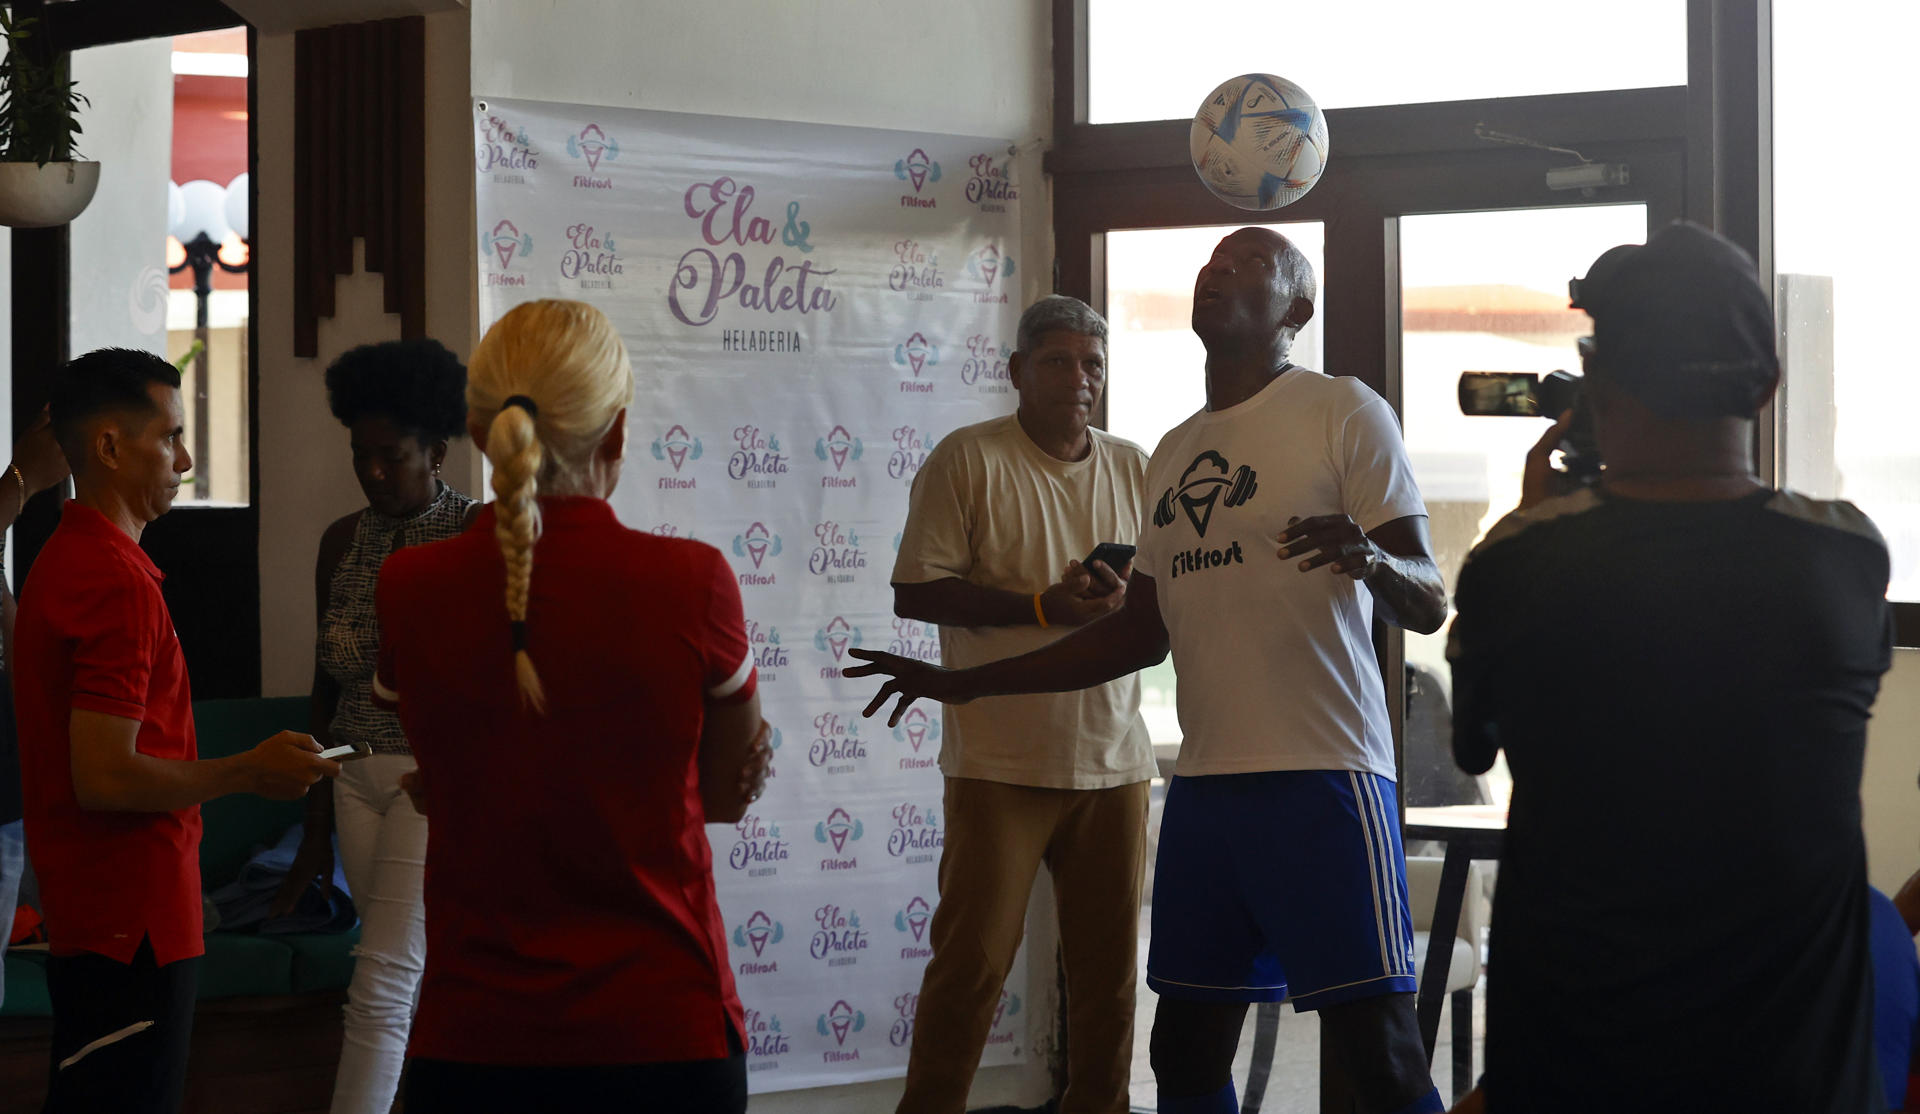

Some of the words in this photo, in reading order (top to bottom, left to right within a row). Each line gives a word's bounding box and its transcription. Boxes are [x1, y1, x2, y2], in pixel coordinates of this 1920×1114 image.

[479, 116, 515, 143] Ela
[475, 144, 539, 173] Paleta
[965, 177, 1019, 203] Paleta
[684, 176, 777, 247] Ela
[782, 201, 815, 254] &
[566, 223, 601, 250] Ela
[560, 250, 624, 280] Paleta
[894, 239, 925, 264] Ela
[668, 248, 838, 327] Paleta
[889, 263, 945, 292] Paleta
[723, 329, 801, 353] HELADERIA
[966, 334, 997, 359] Ela
[961, 358, 1011, 386] Palet
[733, 424, 766, 451] Ela
[892, 425, 921, 451] Ela
[728, 450, 790, 481] Paleta
[814, 520, 845, 547] Ela
[809, 546, 869, 576] Paleta
[813, 711, 845, 738] Ela
[808, 738, 869, 767] Paleta
[735, 814, 767, 840] Ela
[892, 802, 923, 829] Ela
[729, 840, 790, 870] Paleta
[887, 828, 944, 857] Paleta
[814, 903, 846, 930] Ela
[809, 930, 869, 960] Paleta
